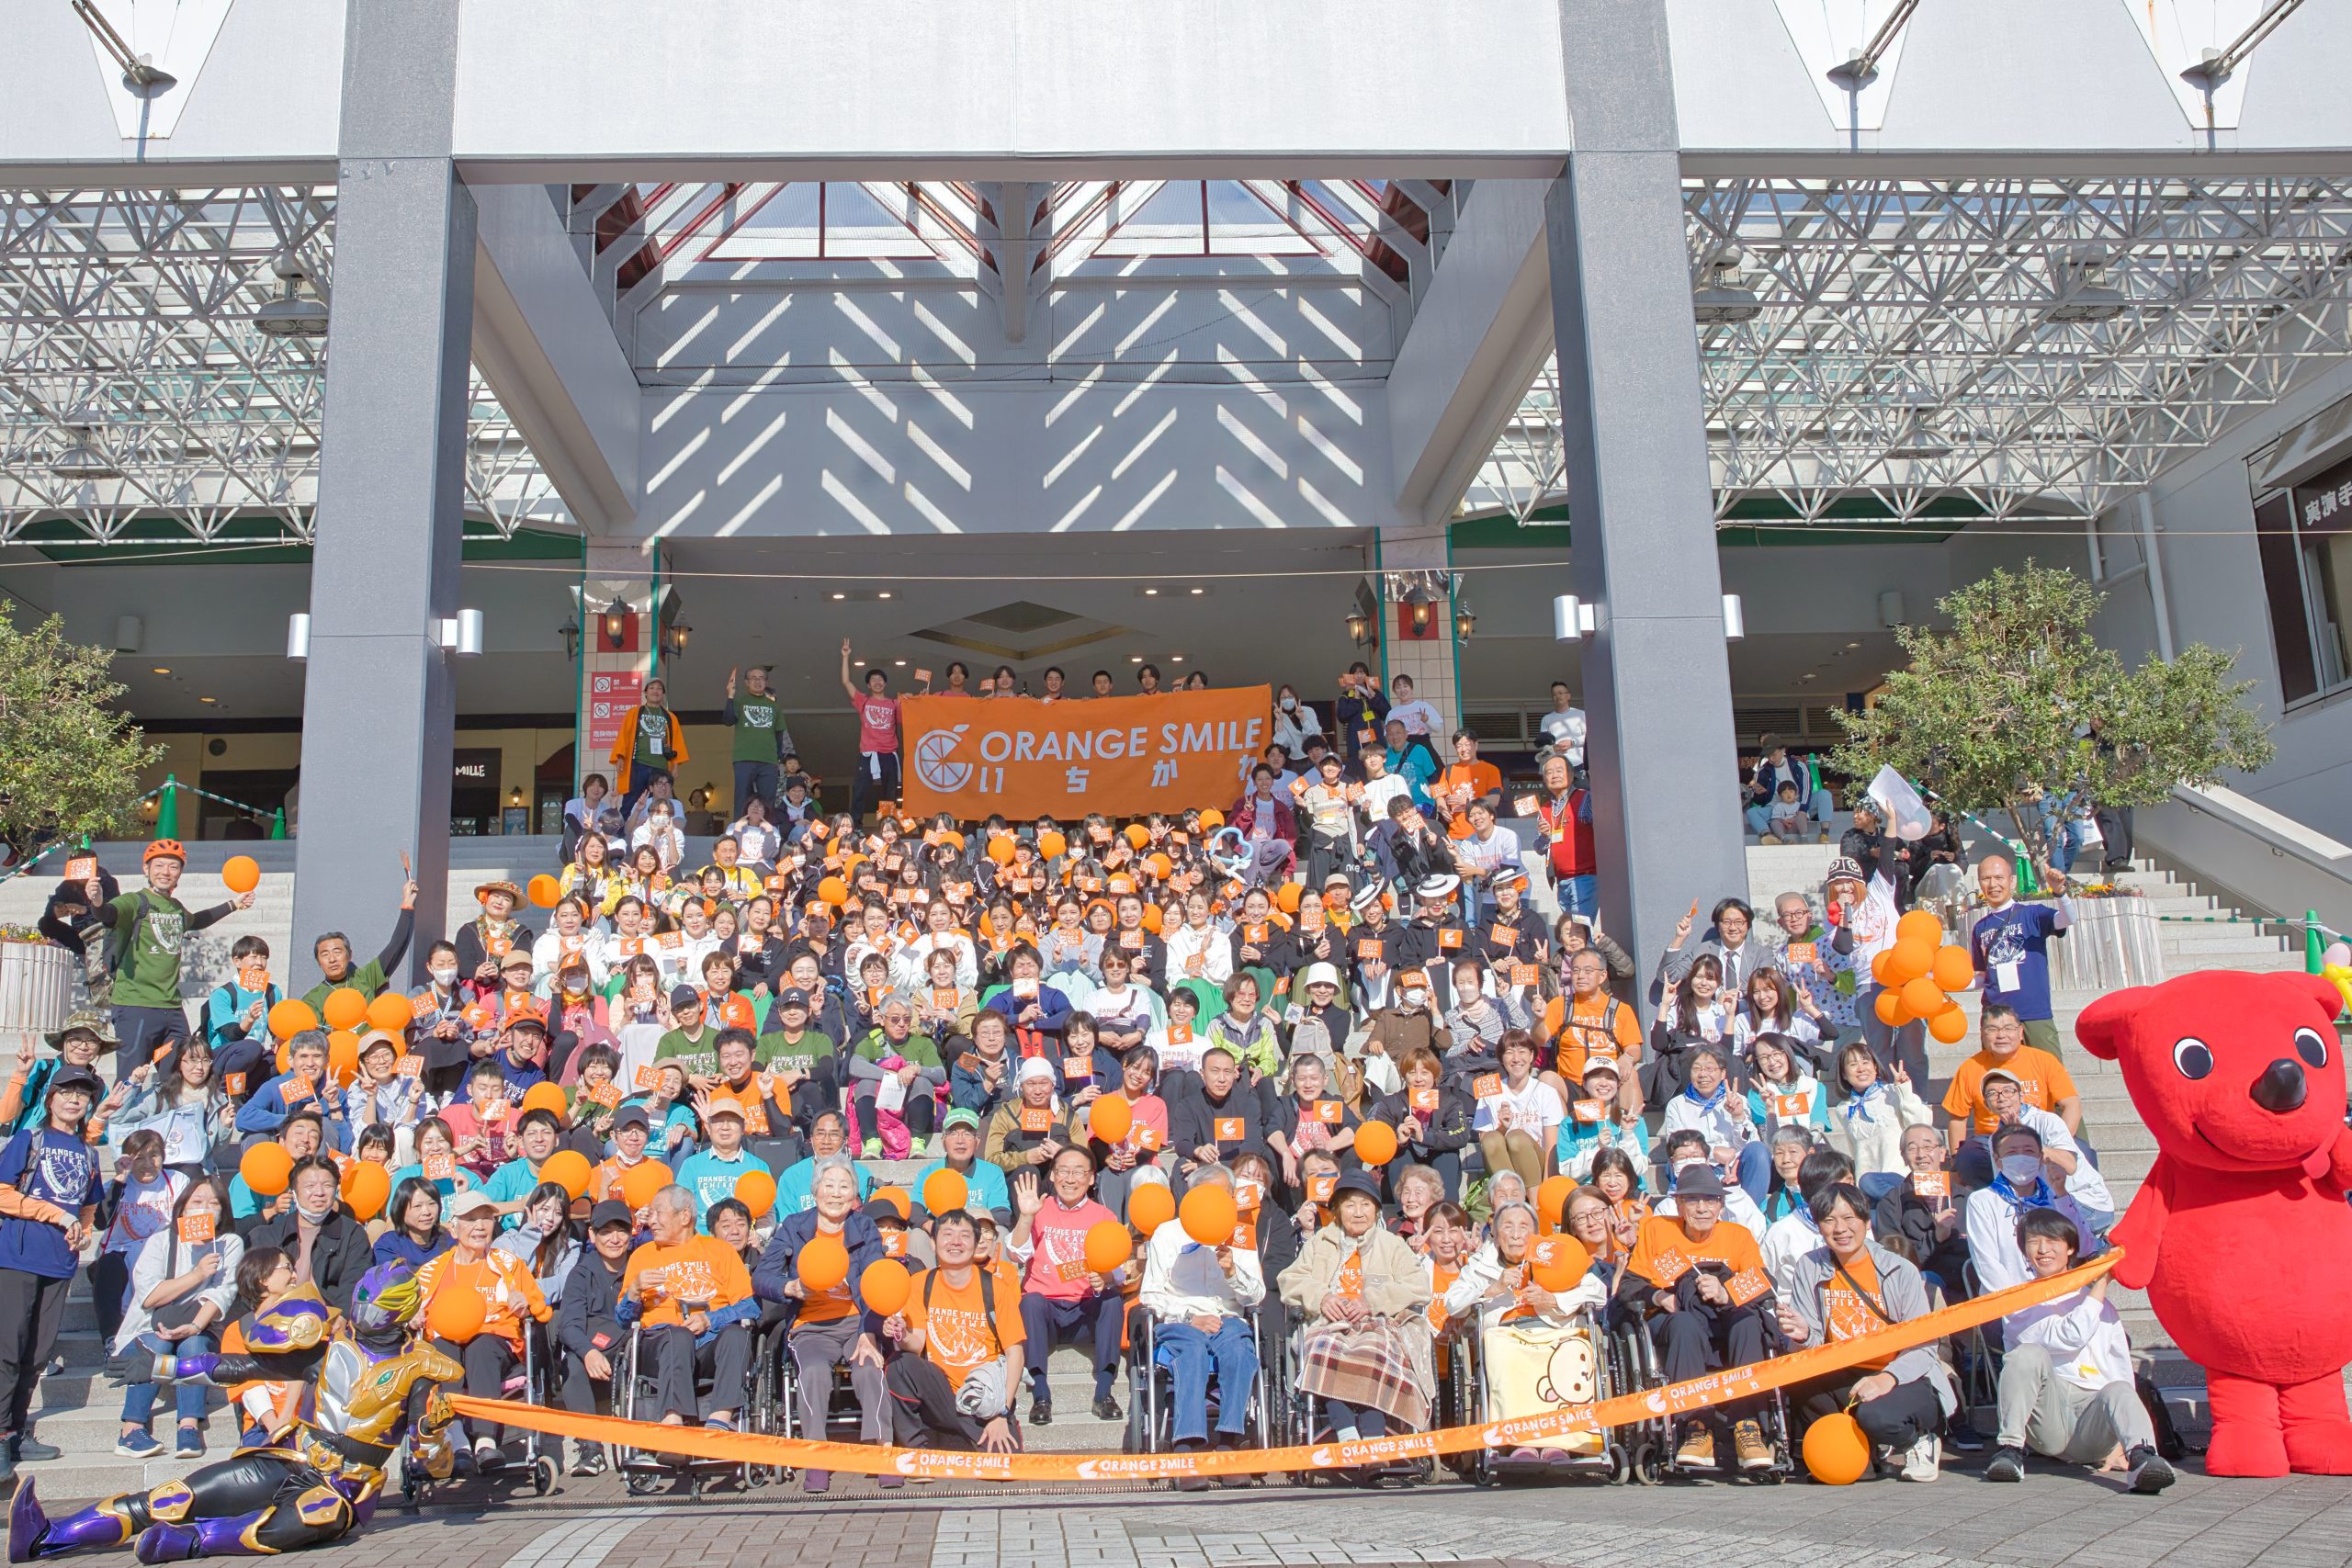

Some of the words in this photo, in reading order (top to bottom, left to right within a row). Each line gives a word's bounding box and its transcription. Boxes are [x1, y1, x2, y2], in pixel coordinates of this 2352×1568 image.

[980, 728, 1148, 762] ORANGE
[1159, 718, 1263, 754] SMILE
[929, 1307, 958, 1317] RANGE
[959, 1311, 988, 1321] SMILE
[929, 1315, 987, 1328] CHIKAWA
[1669, 1378, 1719, 1399] ORANGE
[1722, 1367, 1754, 1384] SMILE
[1504, 1416, 1557, 1436] ORANGE
[1558, 1408, 1593, 1424] SMILE
[1341, 1441, 1396, 1457] ORANGE
[1397, 1436, 1434, 1450] SMILE
[920, 1454, 973, 1467] ORANGE
[976, 1456, 1011, 1469] SMILE
[1101, 1460, 1157, 1471] ORANGE
[1159, 1458, 1194, 1470] SMILE
